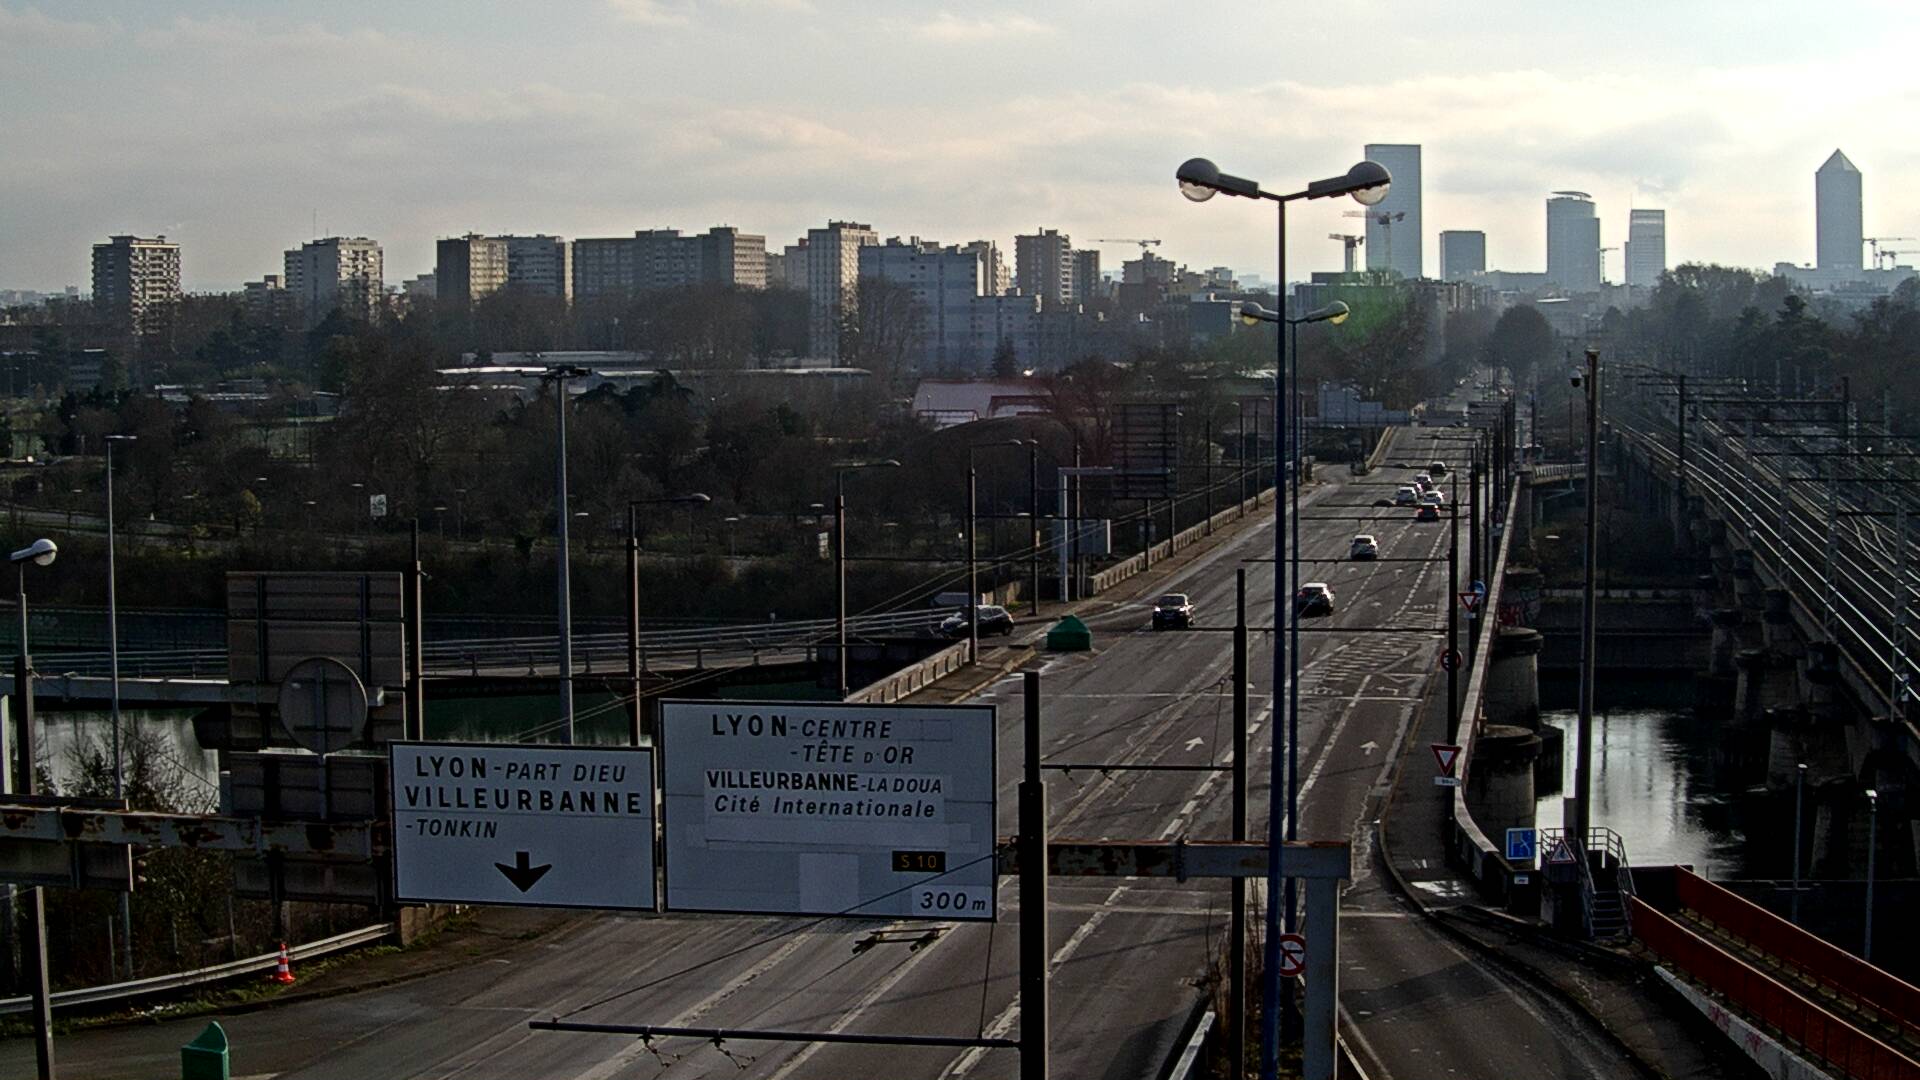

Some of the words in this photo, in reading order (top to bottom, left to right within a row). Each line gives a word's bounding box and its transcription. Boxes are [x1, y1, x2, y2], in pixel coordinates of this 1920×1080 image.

[711, 714, 893, 739] LYON-CENTRE
[416, 756, 562, 781] LYON-PART
[573, 764, 626, 783] DIEU
[893, 777, 942, 794] DOUA
[405, 786, 641, 814] VILLEURBANNE
[715, 795, 760, 813] Cité
[773, 796, 935, 818] Internationale
[901, 855, 910, 868] S
[917, 855, 937, 869] 10
